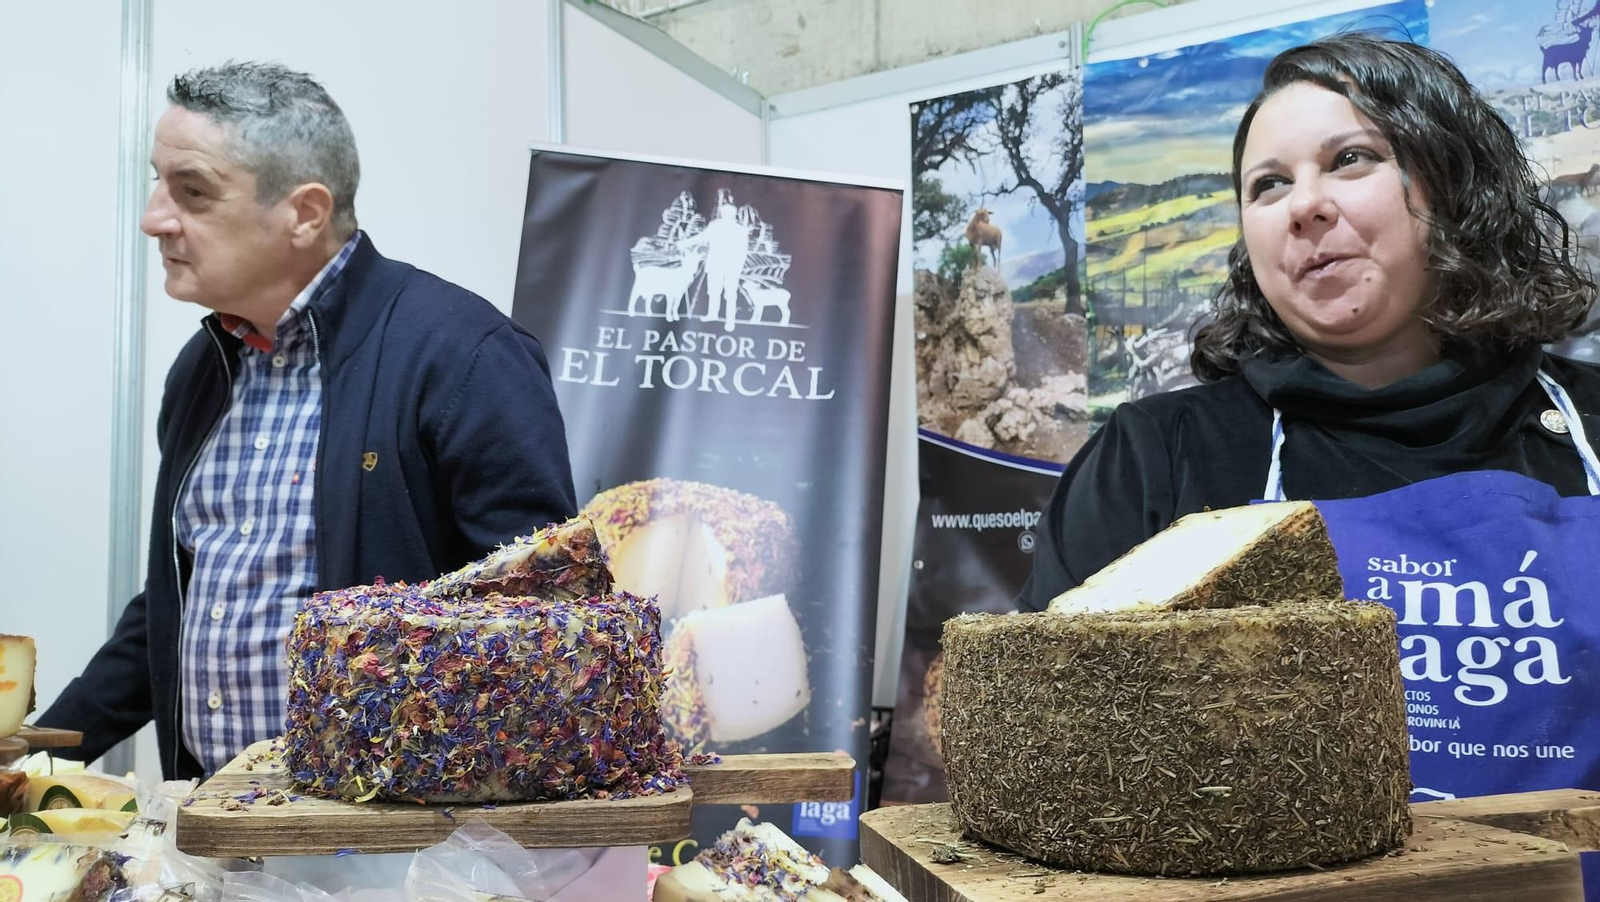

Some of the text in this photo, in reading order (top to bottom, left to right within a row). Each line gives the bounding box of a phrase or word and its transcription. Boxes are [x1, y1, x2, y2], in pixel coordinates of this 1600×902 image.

[596, 326, 806, 363] EL PASTOR DE
[558, 346, 836, 400] EL TORCAL
[931, 508, 1042, 532] www.quesoelpa
[1367, 554, 1457, 577] sabor
[1366, 550, 1565, 629] a má
[1399, 634, 1573, 706] aga
[1404, 690, 1431, 702] CTOS
[1407, 703, 1439, 716] ONOS
[1409, 735, 1575, 759] bor que nos une
